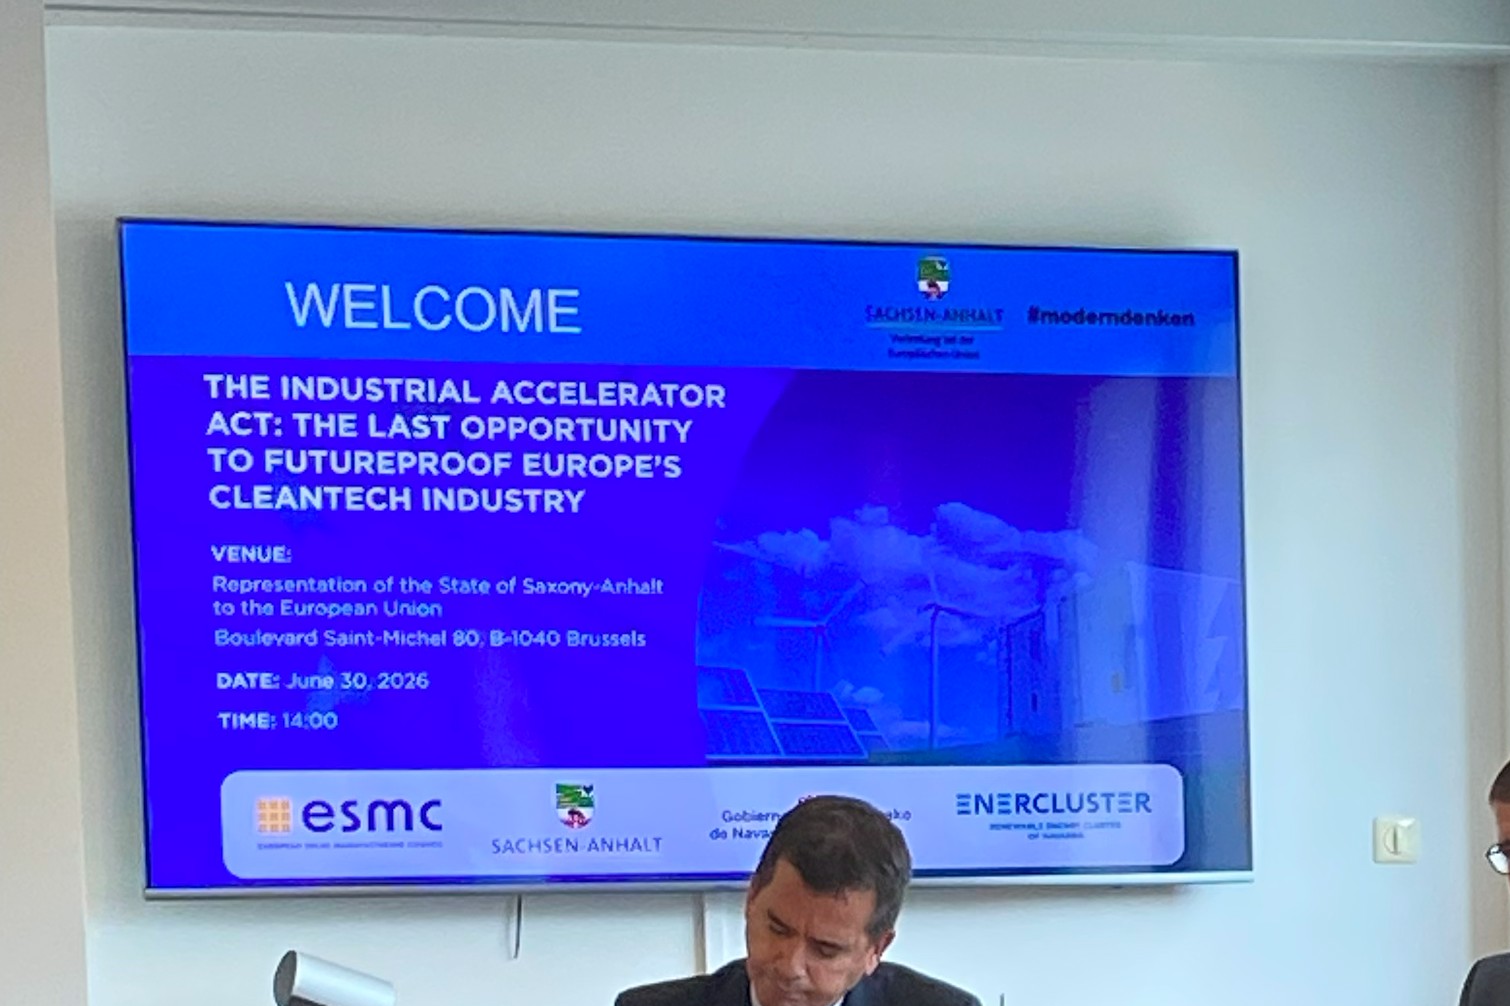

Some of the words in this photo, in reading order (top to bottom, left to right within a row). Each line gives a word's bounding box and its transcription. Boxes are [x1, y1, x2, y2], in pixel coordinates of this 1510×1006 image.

[284, 280, 583, 335] WELCOME
[1027, 305, 1195, 328] #moderndenken
[203, 374, 270, 399] THE
[280, 375, 481, 404] INDUSTRIAL
[490, 380, 726, 408] ACCELERATOR
[205, 411, 283, 437] ACT:
[292, 412, 358, 438] THE
[367, 413, 451, 440] LAST
[460, 415, 693, 443] OPPORTUNITY
[206, 447, 254, 473] TO
[264, 448, 512, 477] FUTUREPROOF
[522, 452, 682, 478] EUROPE’S
[208, 484, 412, 511] CLEANTECH
[421, 486, 586, 513] INDUSTRY
[210, 545, 292, 563] VENUE:
[212, 575, 368, 595] Representation
[373, 576, 395, 593] of
[399, 577, 433, 594] the
[438, 575, 491, 595] State
[496, 576, 517, 594] of
[522, 576, 664, 598] Saxony-Anhalt
[213, 601, 235, 616] to
[240, 599, 274, 616] the
[280, 598, 378, 618] European
[383, 599, 443, 617] Union
[214, 628, 318, 647] Boulevard
[323, 629, 447, 647] Saint-Michel
[489, 629, 561, 647] B-1040
[567, 630, 647, 647] Brussels
[216, 672, 280, 690] DATE:
[285, 672, 334, 690] June
[340, 673, 372, 691] 30,
[377, 673, 430, 690] 2026
[217, 712, 277, 730] TIME:
[283, 712, 338, 730] 14:00
[956, 792, 1152, 816] ENERCLUSTER
[301, 798, 443, 834] esmc
[722, 810, 781, 823] Gobiern
[732, 828, 773, 840] Nava
